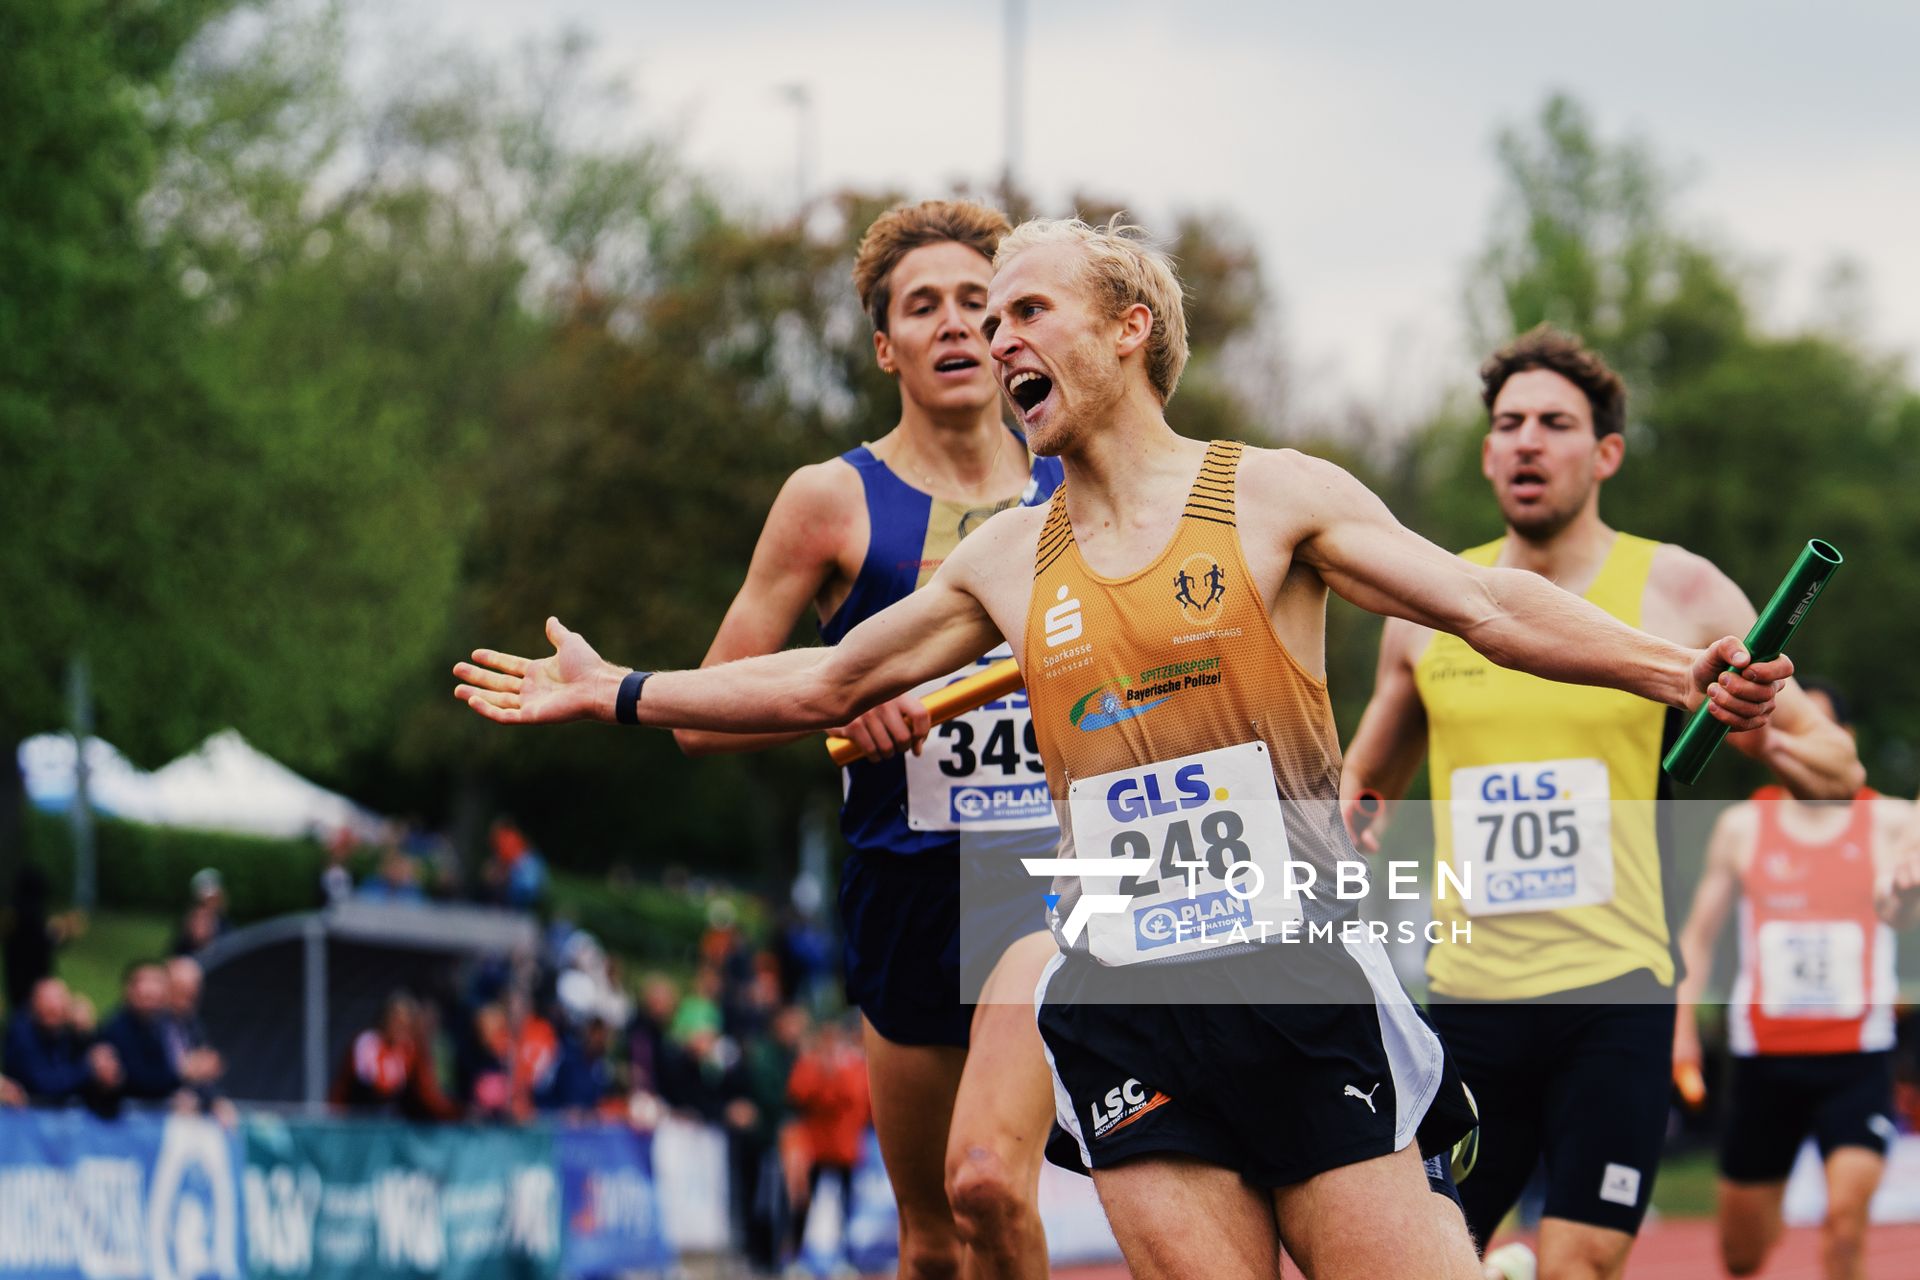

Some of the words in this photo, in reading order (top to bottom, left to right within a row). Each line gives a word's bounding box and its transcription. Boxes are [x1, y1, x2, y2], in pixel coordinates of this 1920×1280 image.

[1787, 581, 1821, 625] BENZ
[1173, 629, 1216, 645] RUNNING
[1217, 627, 1242, 639] GAGS
[1043, 643, 1092, 667] Sparkasse
[1140, 656, 1221, 683] SPITZENSPORT
[1126, 679, 1182, 702] Bayerische
[1184, 671, 1221, 689] Polizei
[993, 787, 1048, 808] PLAN
[1477, 809, 1580, 863] 705
[1111, 810, 1251, 898] 248
[1181, 896, 1245, 923] PLAN
[1184, 916, 1248, 935] NTENATIONAL
[1091, 1078, 1145, 1130] LSC
[1128, 1101, 1147, 1114] AISCH
